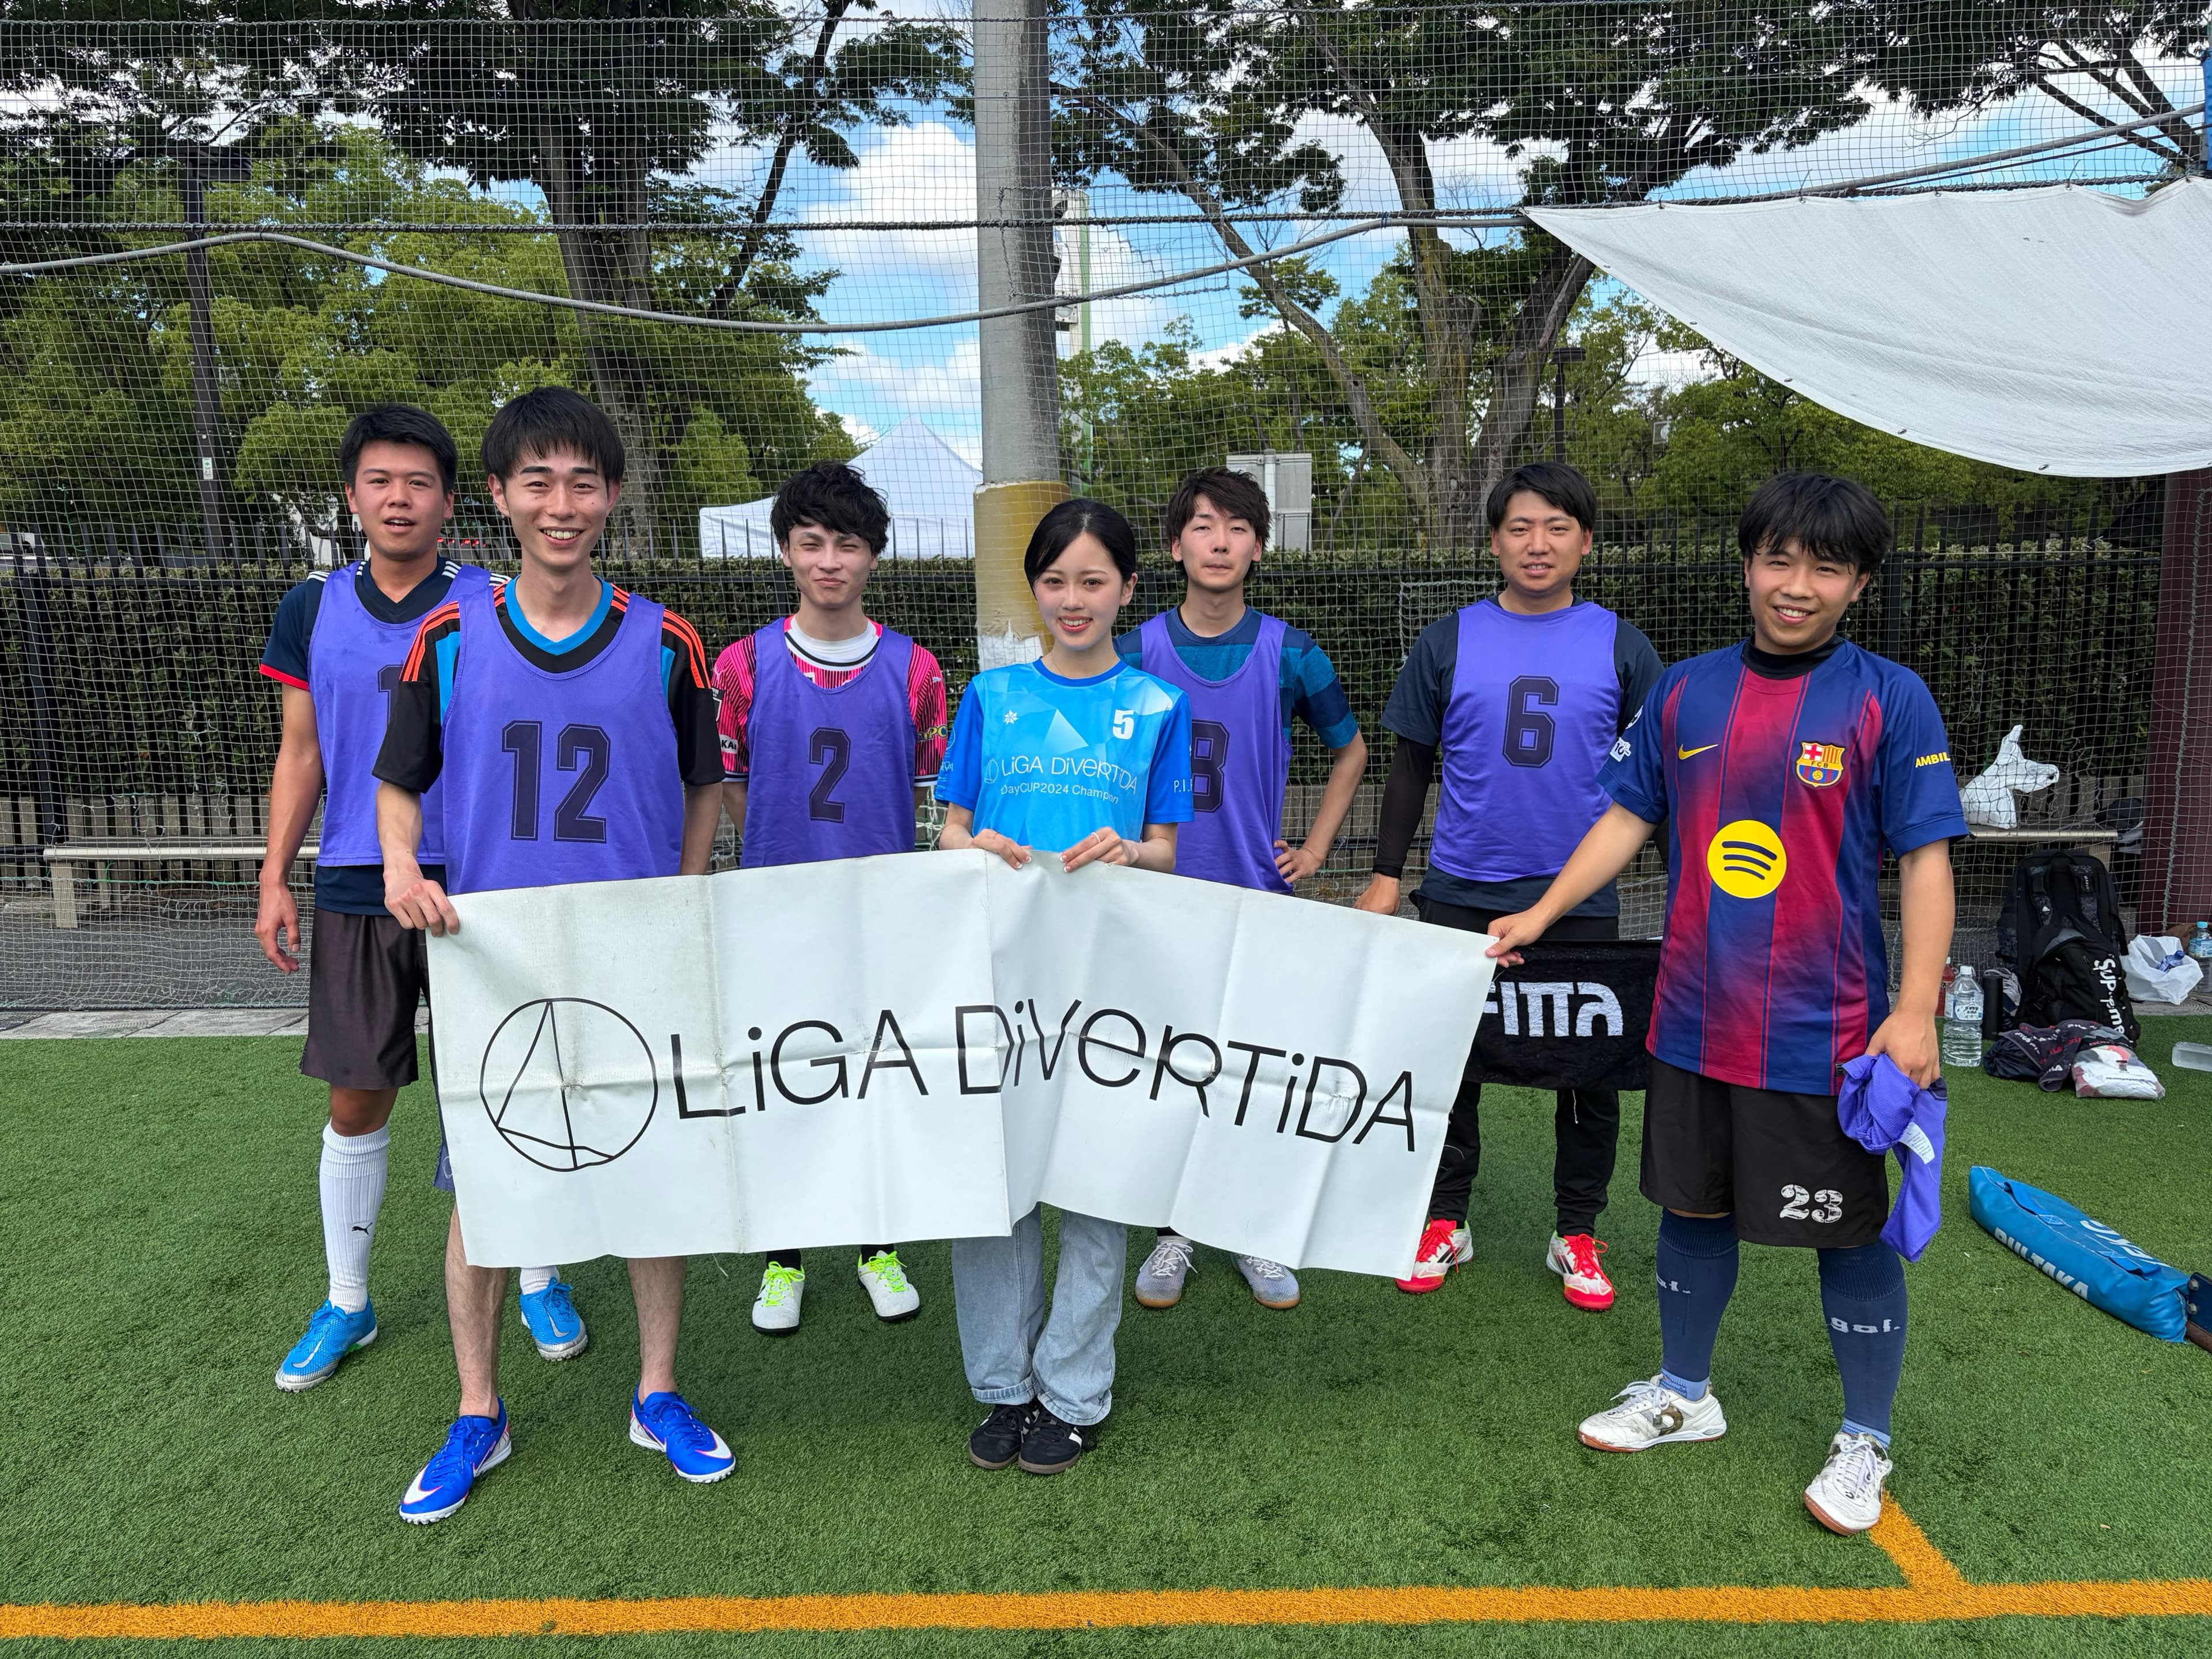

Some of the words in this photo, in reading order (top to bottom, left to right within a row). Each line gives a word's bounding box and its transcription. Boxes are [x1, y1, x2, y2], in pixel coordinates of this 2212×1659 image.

[1112, 709, 1134, 740] 5
[1502, 675, 1559, 768] 6
[501, 719, 611, 844] 12
[808, 726, 852, 824] 2
[1915, 752, 1951, 768] AMBIL
[1779, 1184, 1843, 1224] 23
